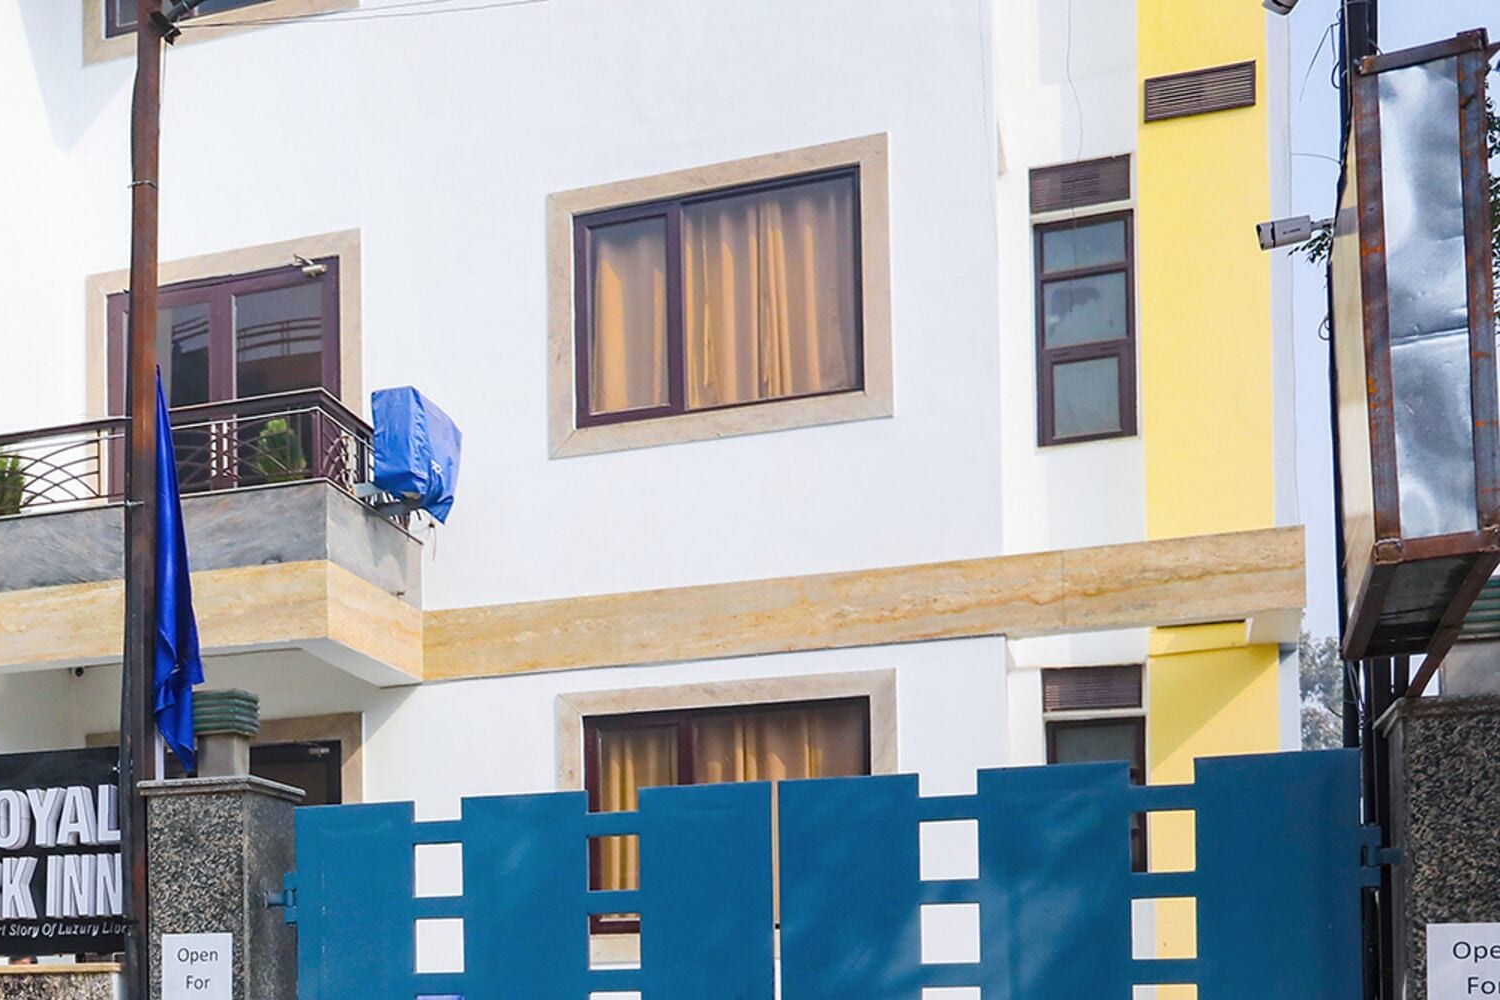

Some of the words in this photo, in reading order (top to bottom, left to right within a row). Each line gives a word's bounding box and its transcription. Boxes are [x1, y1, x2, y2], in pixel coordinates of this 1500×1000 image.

[45, 853, 122, 918] INN
[8, 923, 40, 938] Story
[41, 922, 57, 938] Of
[177, 947, 218, 965] Open
[185, 975, 211, 990] For
[1467, 976, 1500, 995] Fo
